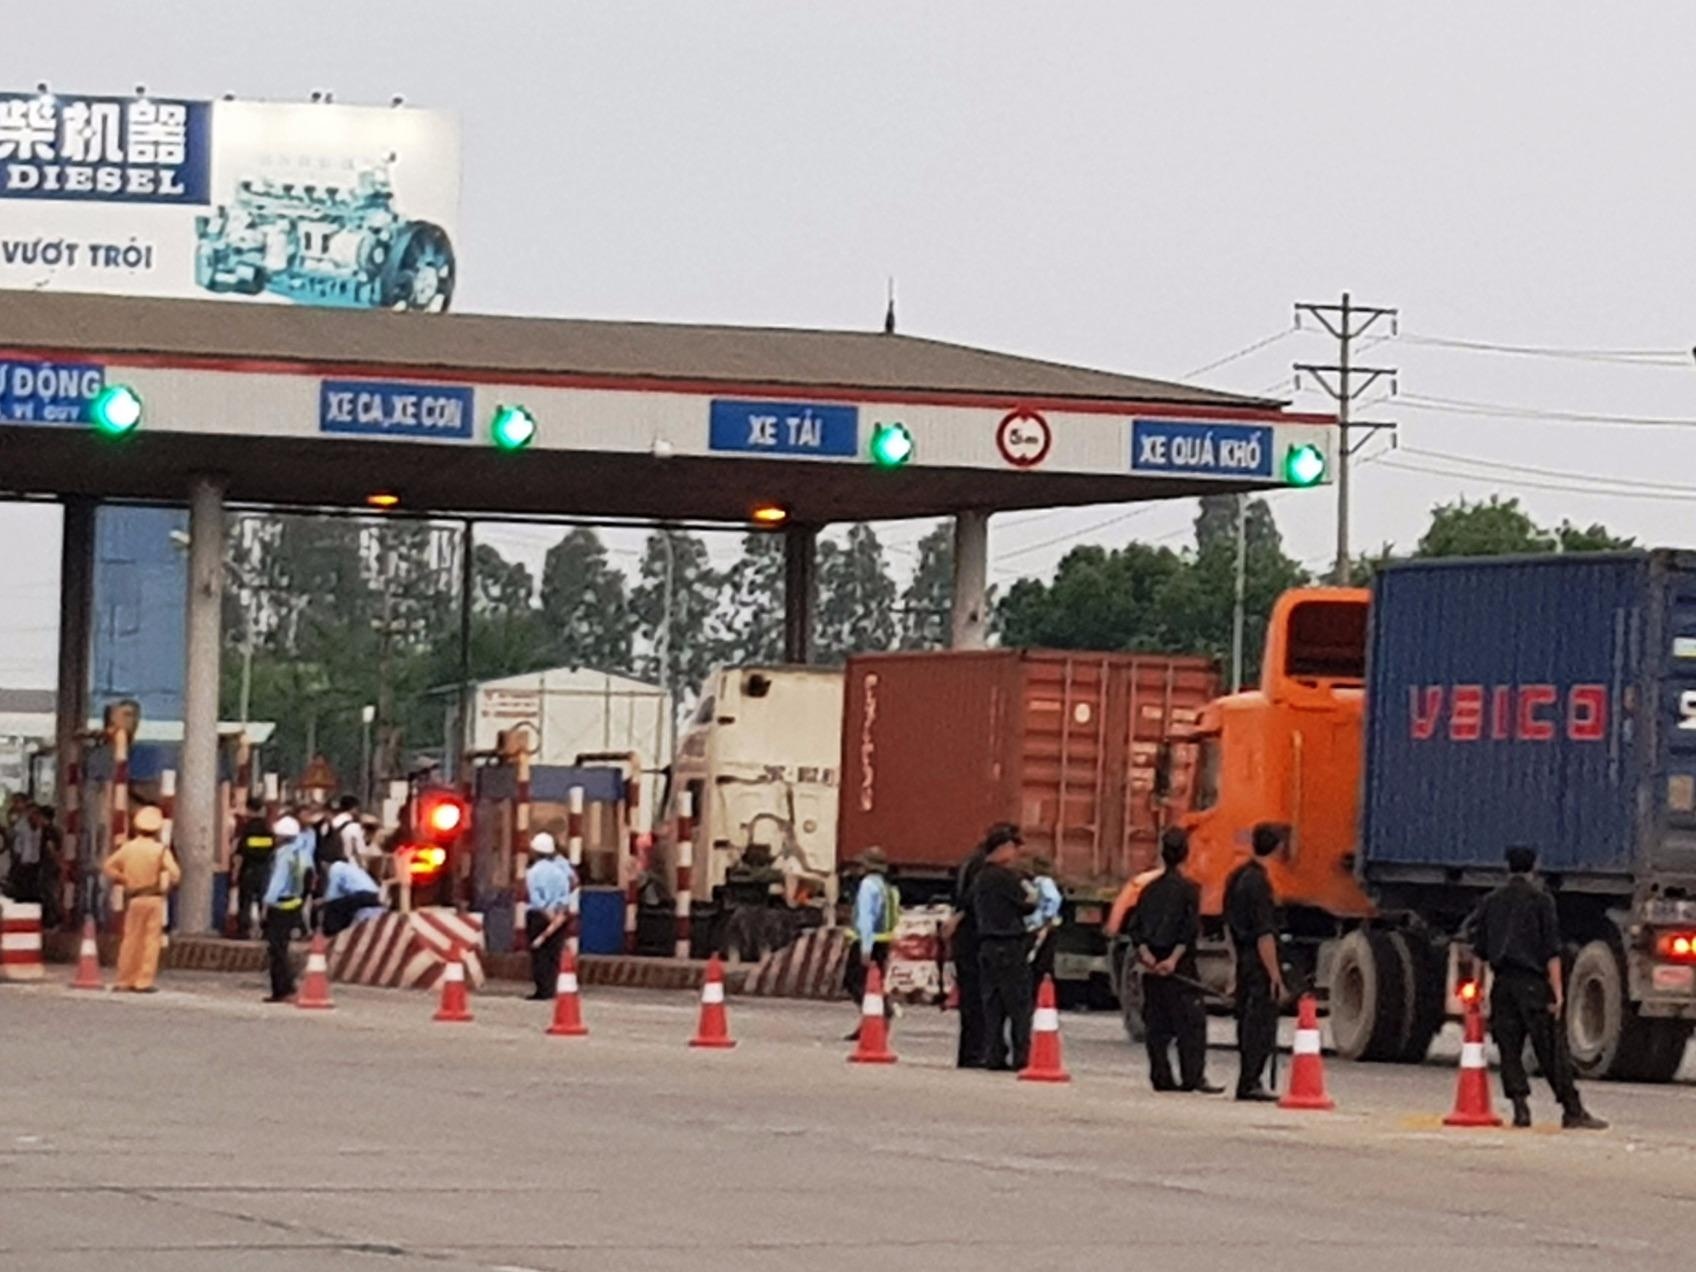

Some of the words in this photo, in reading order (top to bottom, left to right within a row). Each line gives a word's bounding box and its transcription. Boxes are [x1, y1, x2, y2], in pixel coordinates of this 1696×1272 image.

[6, 163, 186, 195] DIESEL
[2, 238, 79, 273] VƯỢT
[748, 415, 778, 445] XE
[785, 408, 823, 447] TẢI
[1139, 434, 1167, 465] XE
[1171, 431, 1215, 467] QUÁ
